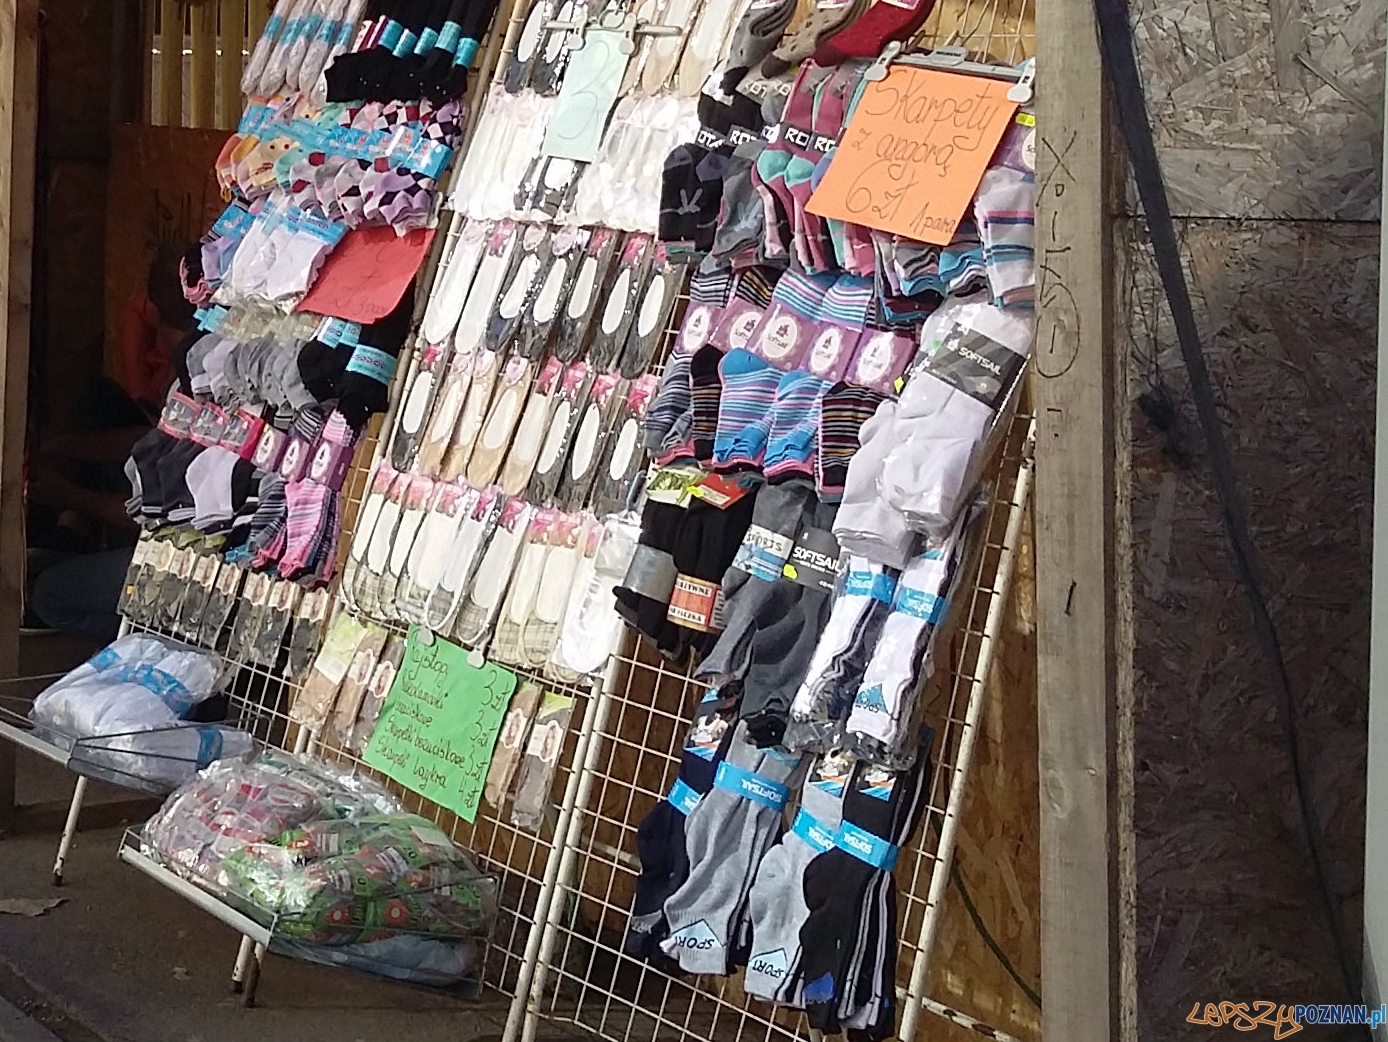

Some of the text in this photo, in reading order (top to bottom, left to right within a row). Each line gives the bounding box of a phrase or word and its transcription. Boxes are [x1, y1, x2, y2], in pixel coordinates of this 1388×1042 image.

[957, 346, 1003, 376] SOFTSAIL
[792, 545, 845, 578] SOFTSAIL
[741, 777, 784, 804] SOFTSAIL
[842, 831, 873, 855] SOFTSAIL
[751, 959, 785, 980] SPORT
